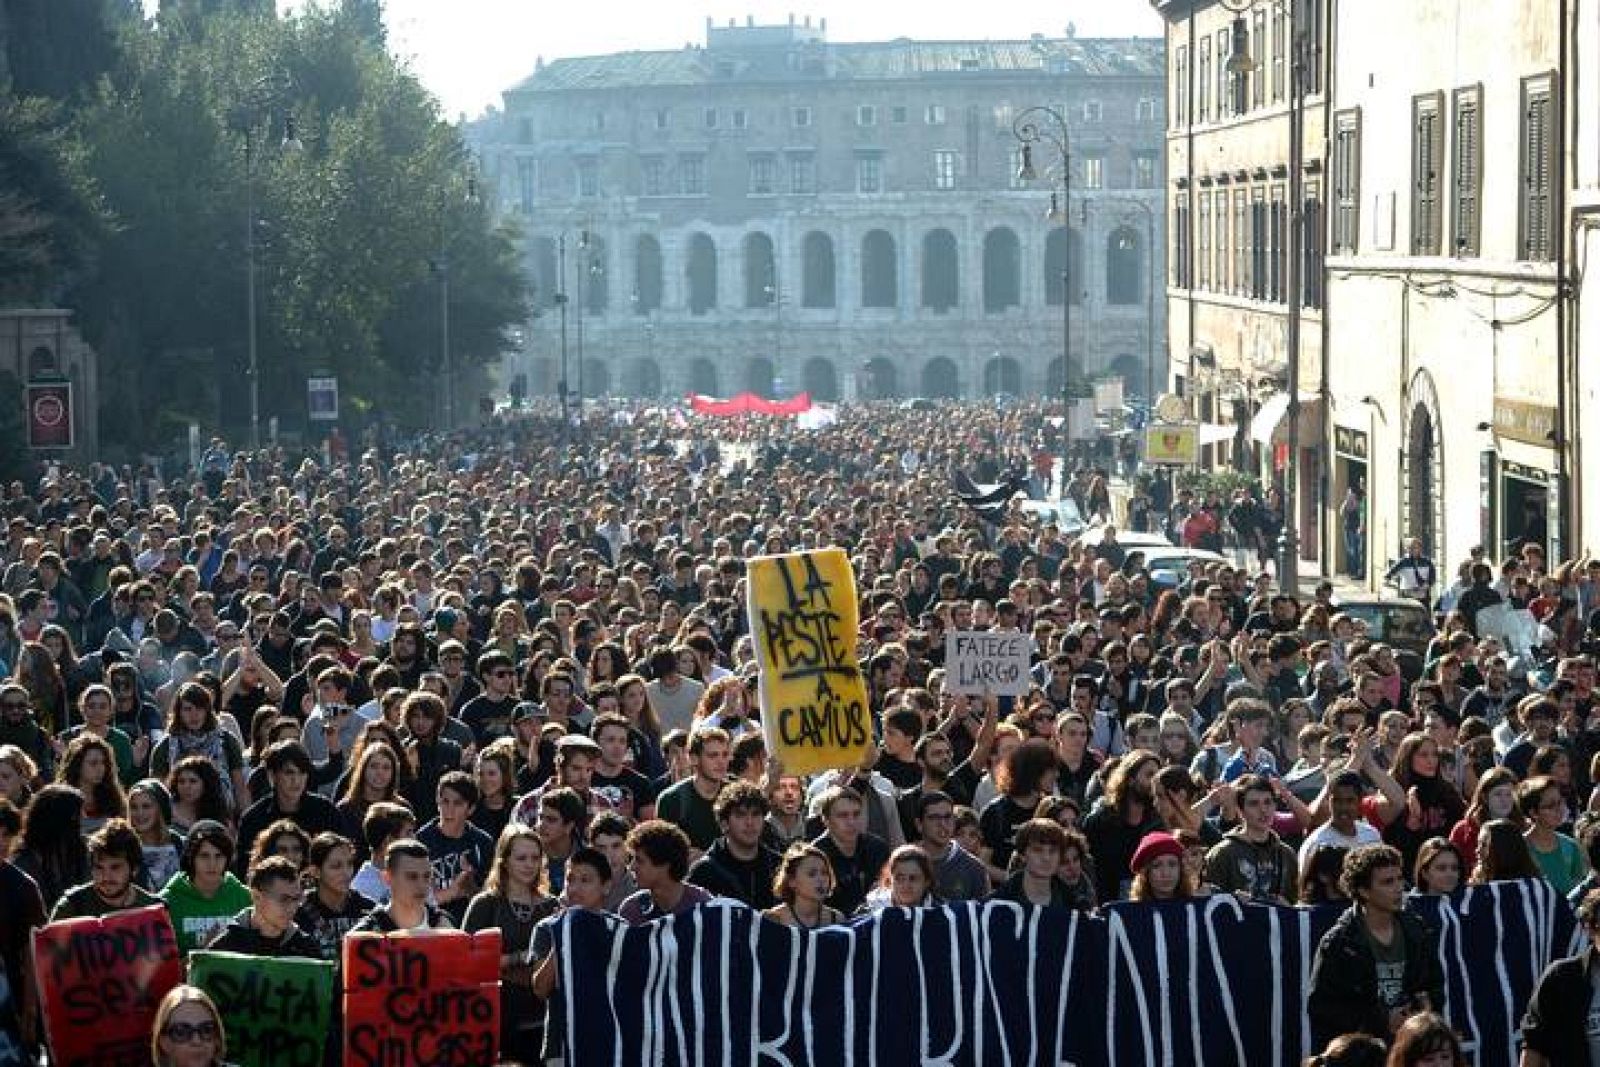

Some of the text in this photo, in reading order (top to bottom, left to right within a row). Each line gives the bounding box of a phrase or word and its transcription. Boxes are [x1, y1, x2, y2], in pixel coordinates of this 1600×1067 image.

[776, 553, 833, 610] LA
[761, 609, 848, 671] PESTE
[959, 660, 1019, 685] LARGO
[357, 940, 429, 988] Sin
